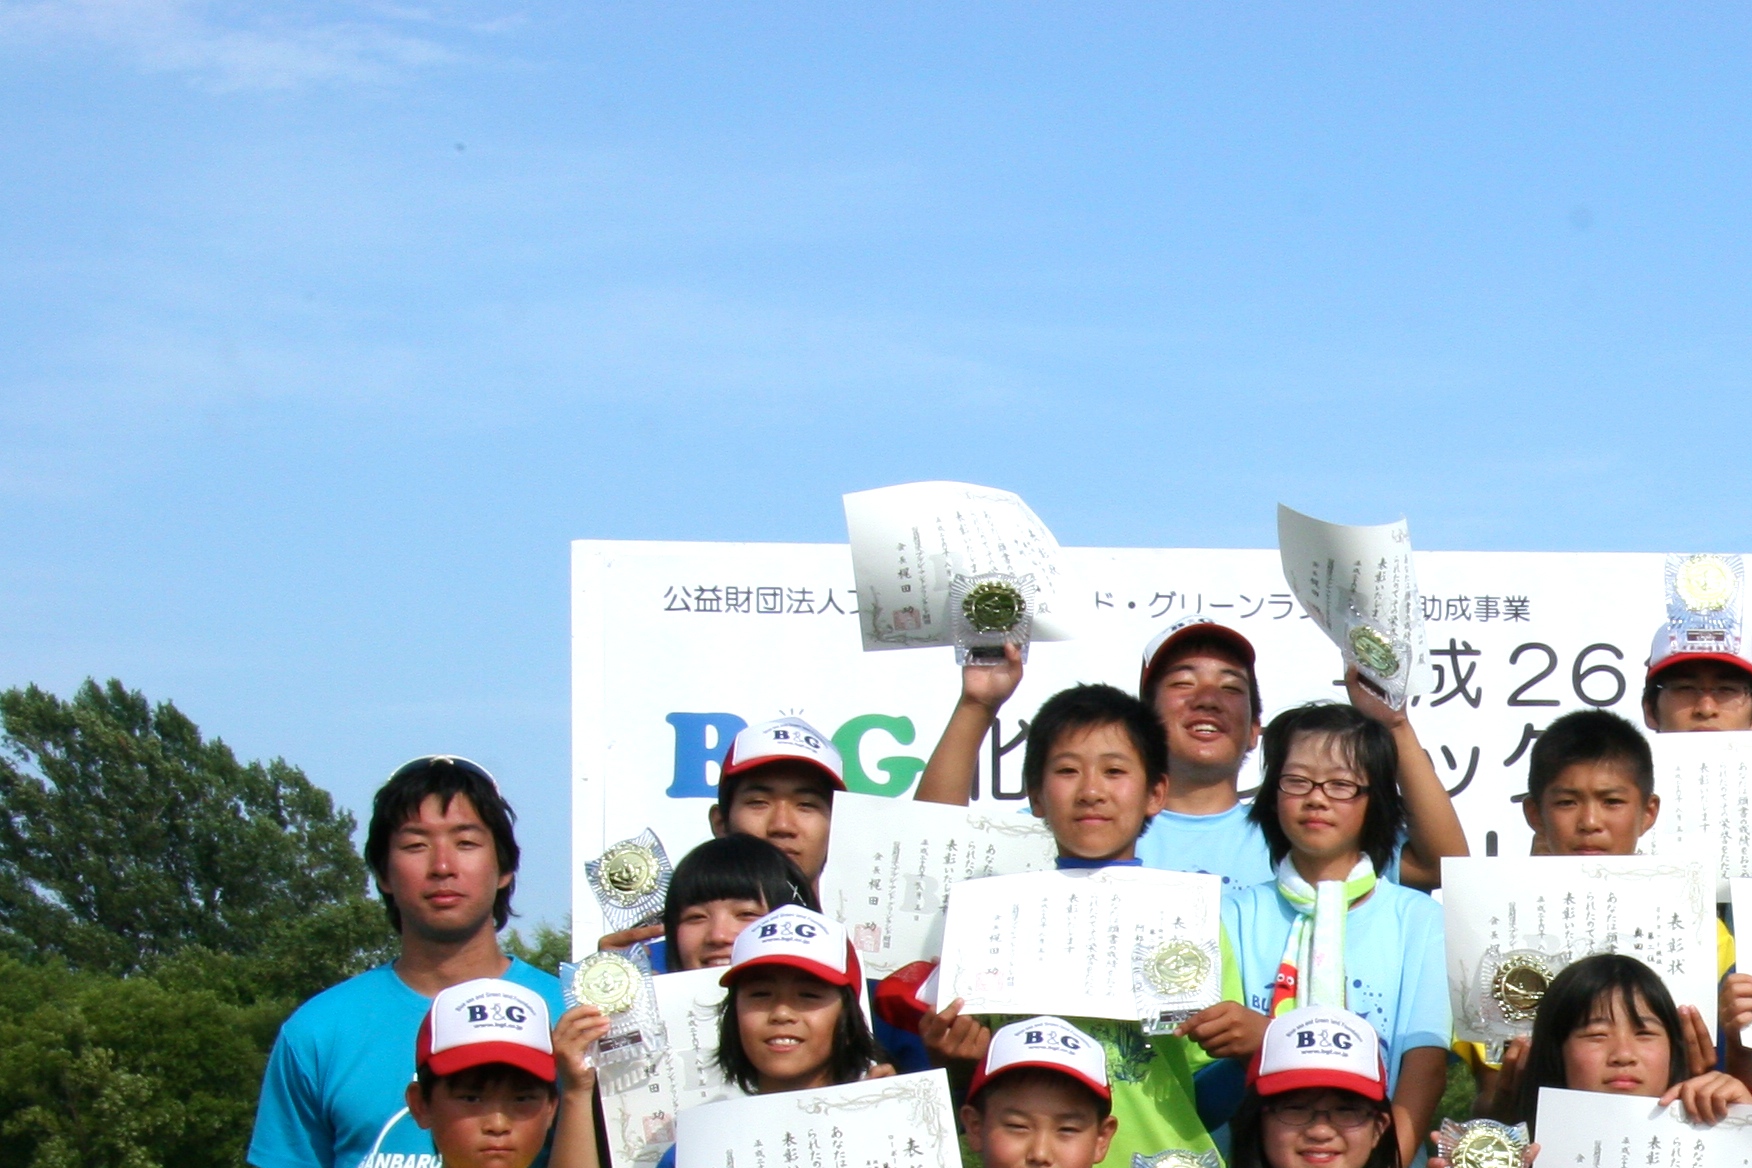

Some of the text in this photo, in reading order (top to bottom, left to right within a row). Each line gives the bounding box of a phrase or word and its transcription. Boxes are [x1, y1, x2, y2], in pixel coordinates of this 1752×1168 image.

[1095, 589, 1310, 620] ド・グリーンラ
[758, 921, 816, 939] B&G
[1666, 911, 1685, 976] 表彰状
[467, 1003, 527, 1023] B&G
[1024, 1031, 1081, 1050] B&G
[1296, 1029, 1352, 1050] B&G
